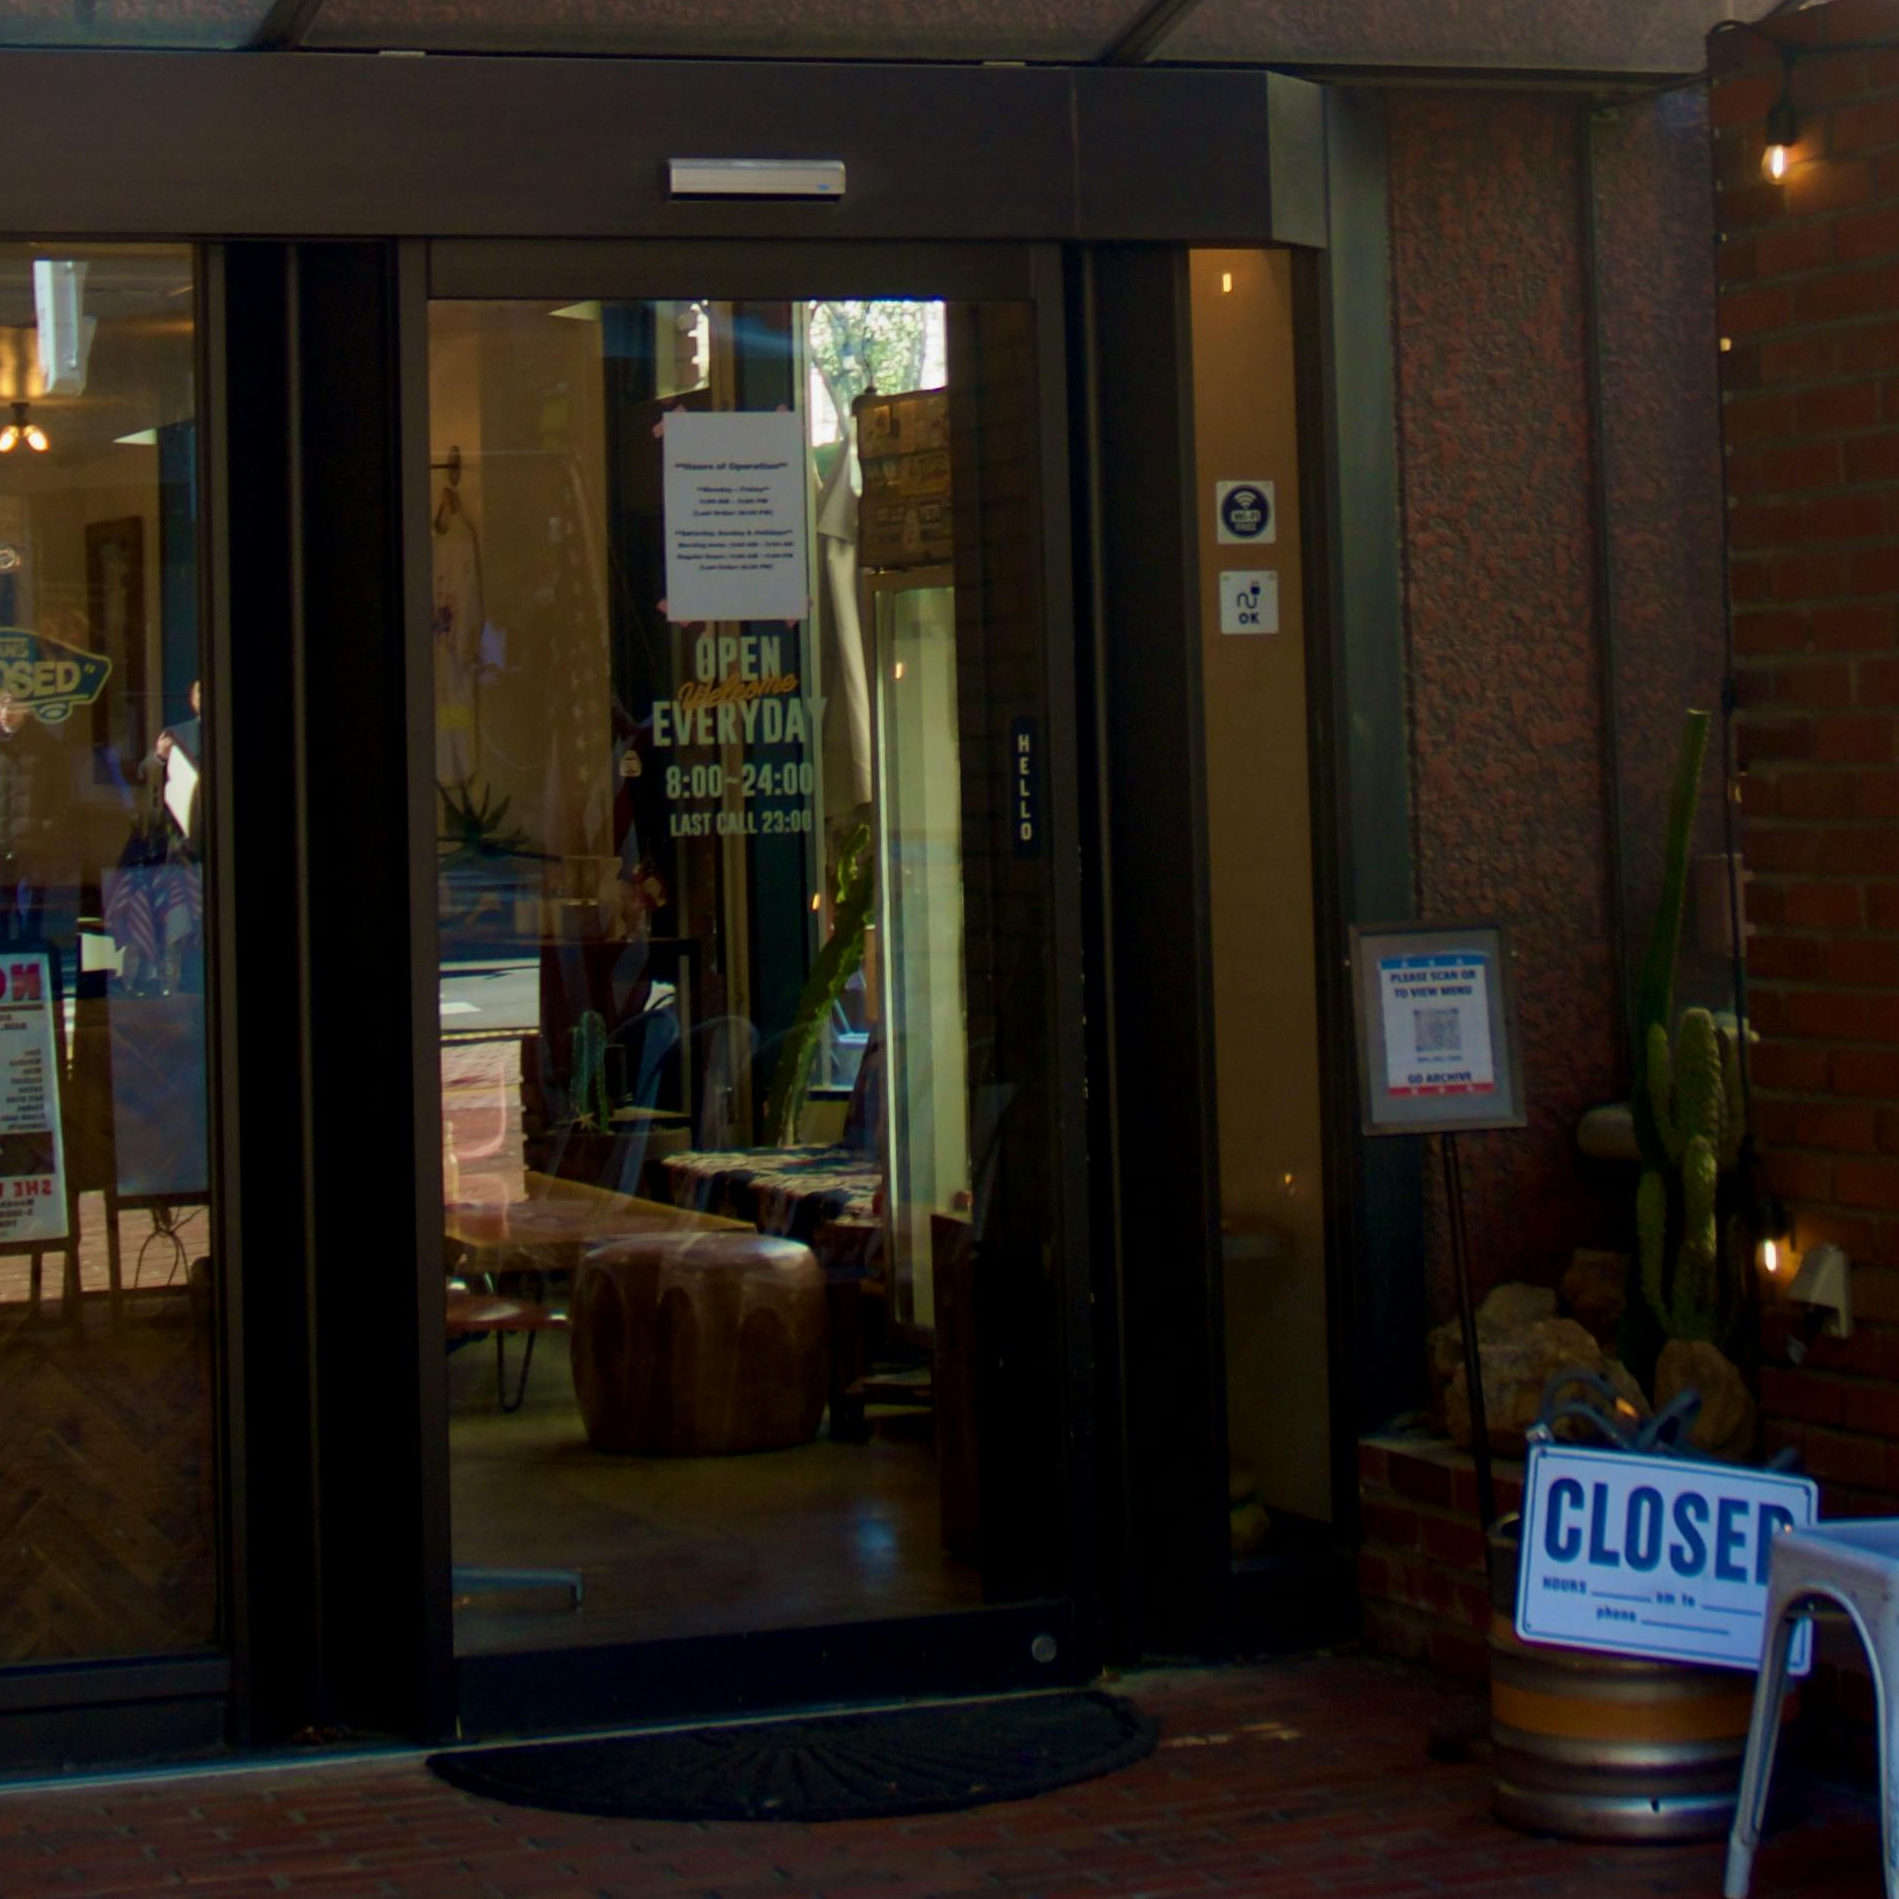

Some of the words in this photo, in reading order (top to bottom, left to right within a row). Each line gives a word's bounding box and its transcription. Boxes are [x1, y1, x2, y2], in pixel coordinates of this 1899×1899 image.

[1238, 612, 1260, 625] OK
[695, 635, 782, 683] OPEN
[677, 672, 800, 711] Welcome
[652, 696, 828, 747] EVERYDAY
[1016, 733, 1033, 842] HELLO
[669, 811, 713, 838] LAST
[715, 809, 758, 836] CALL
[760, 807, 813, 834] 23:00
[1390, 972, 1428, 983] PLEASE
[1430, 971, 1458, 982] SCAN
[1394, 988, 1409, 999] TO
[1410, 987, 1438, 998] VIEW
[1440, 985, 1473, 996] MENU
[1408, 1073, 1423, 1084] GO
[1426, 1071, 1472, 1083] ARCHIVE
[1681, 1592, 1696, 1608] to
[1596, 1605, 1638, 1623] phone
